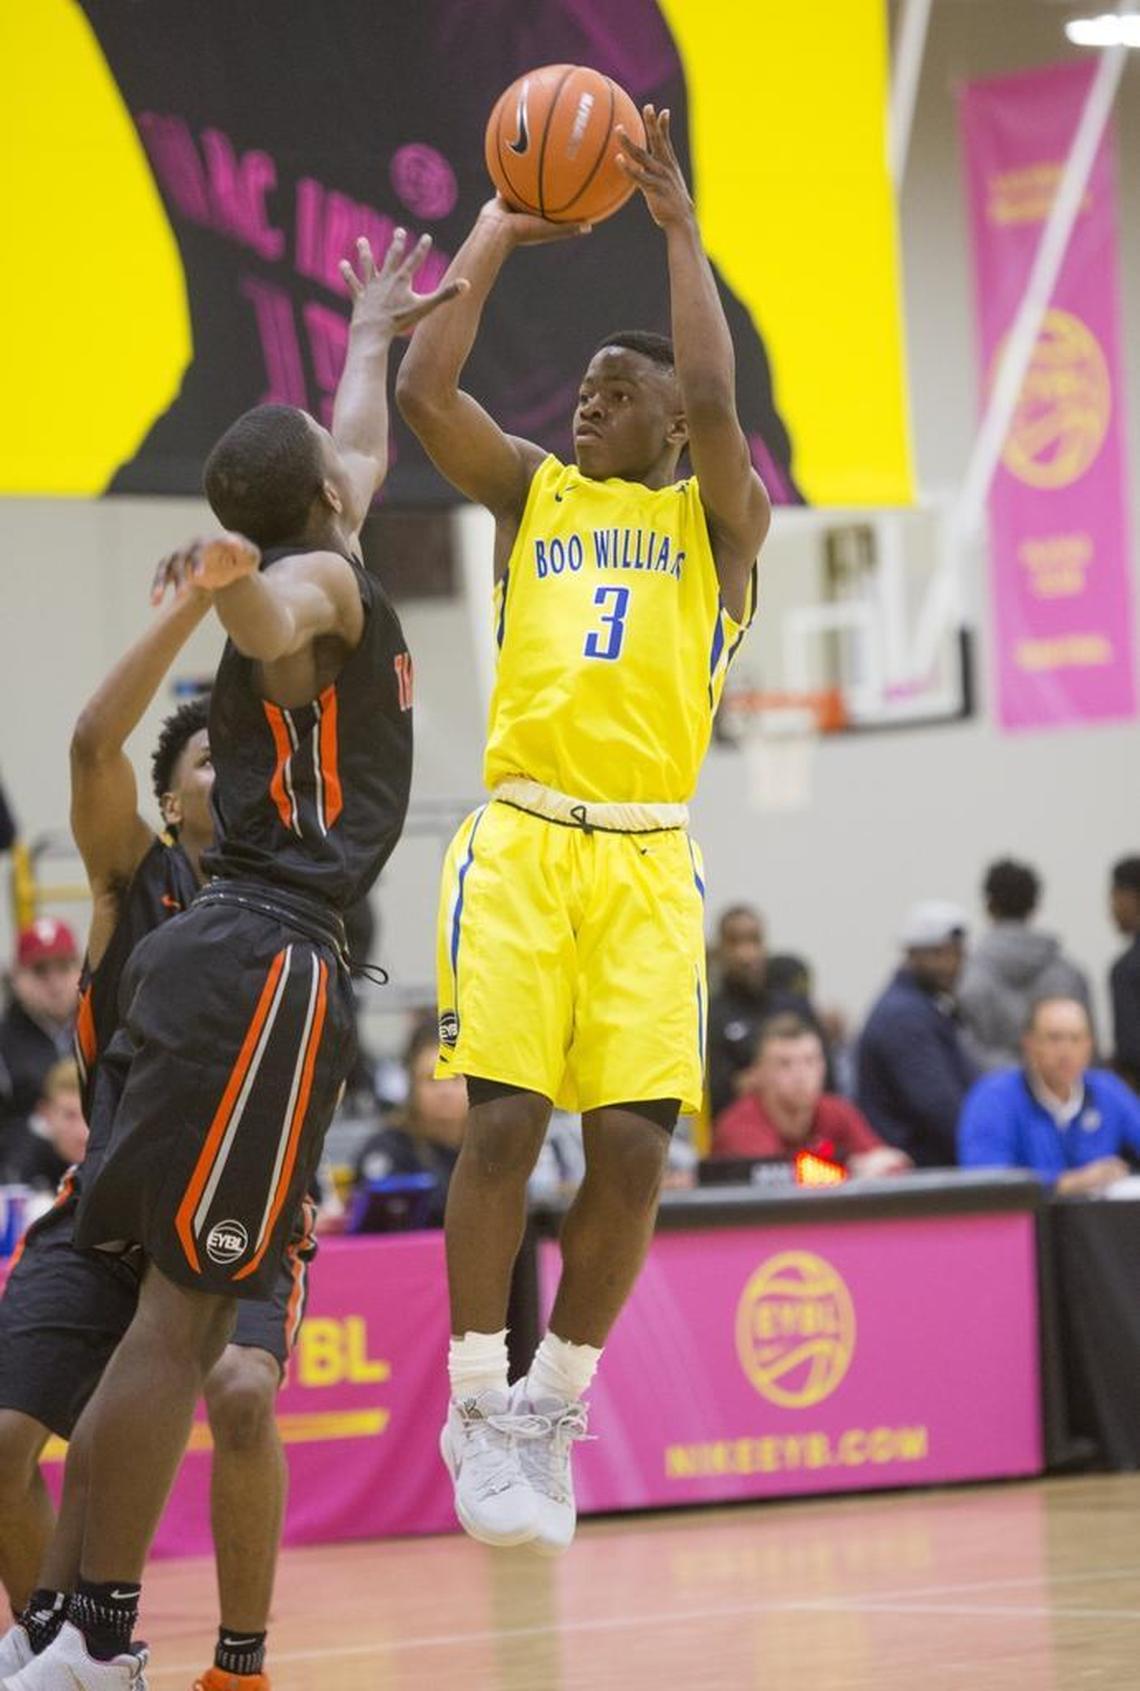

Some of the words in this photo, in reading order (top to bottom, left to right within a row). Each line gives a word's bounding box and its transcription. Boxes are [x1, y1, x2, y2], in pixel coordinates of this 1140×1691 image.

[534, 533, 583, 579] BOO
[583, 586, 630, 661] 3
[207, 1230, 245, 1252] EYBL
